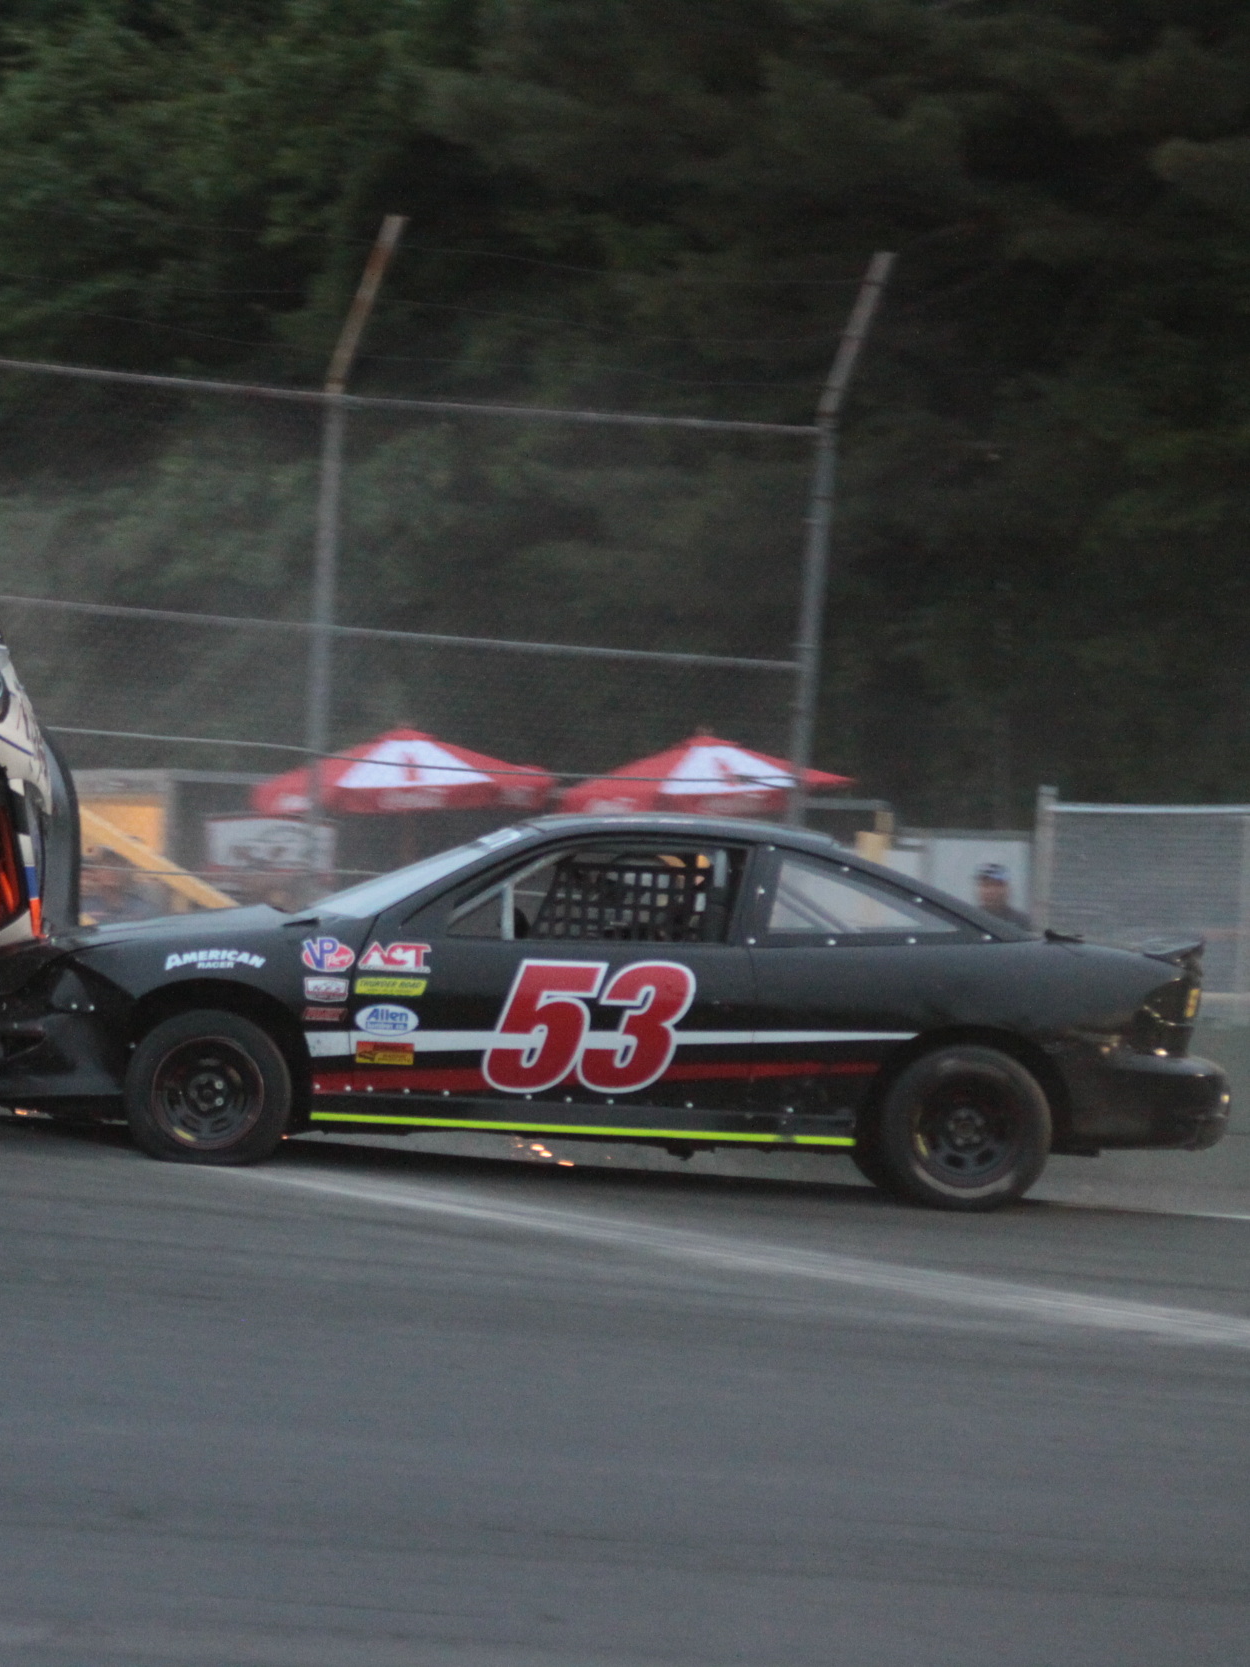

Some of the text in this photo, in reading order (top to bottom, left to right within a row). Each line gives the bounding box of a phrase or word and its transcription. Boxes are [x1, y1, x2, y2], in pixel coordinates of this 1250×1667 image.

[165, 950, 266, 970] AMERICAN
[304, 938, 339, 970] VP
[358, 942, 431, 968] ACT
[196, 961, 234, 969] RACER
[359, 980, 398, 988] THUNDER
[366, 1008, 409, 1022] Allen
[482, 958, 696, 1093] 53
